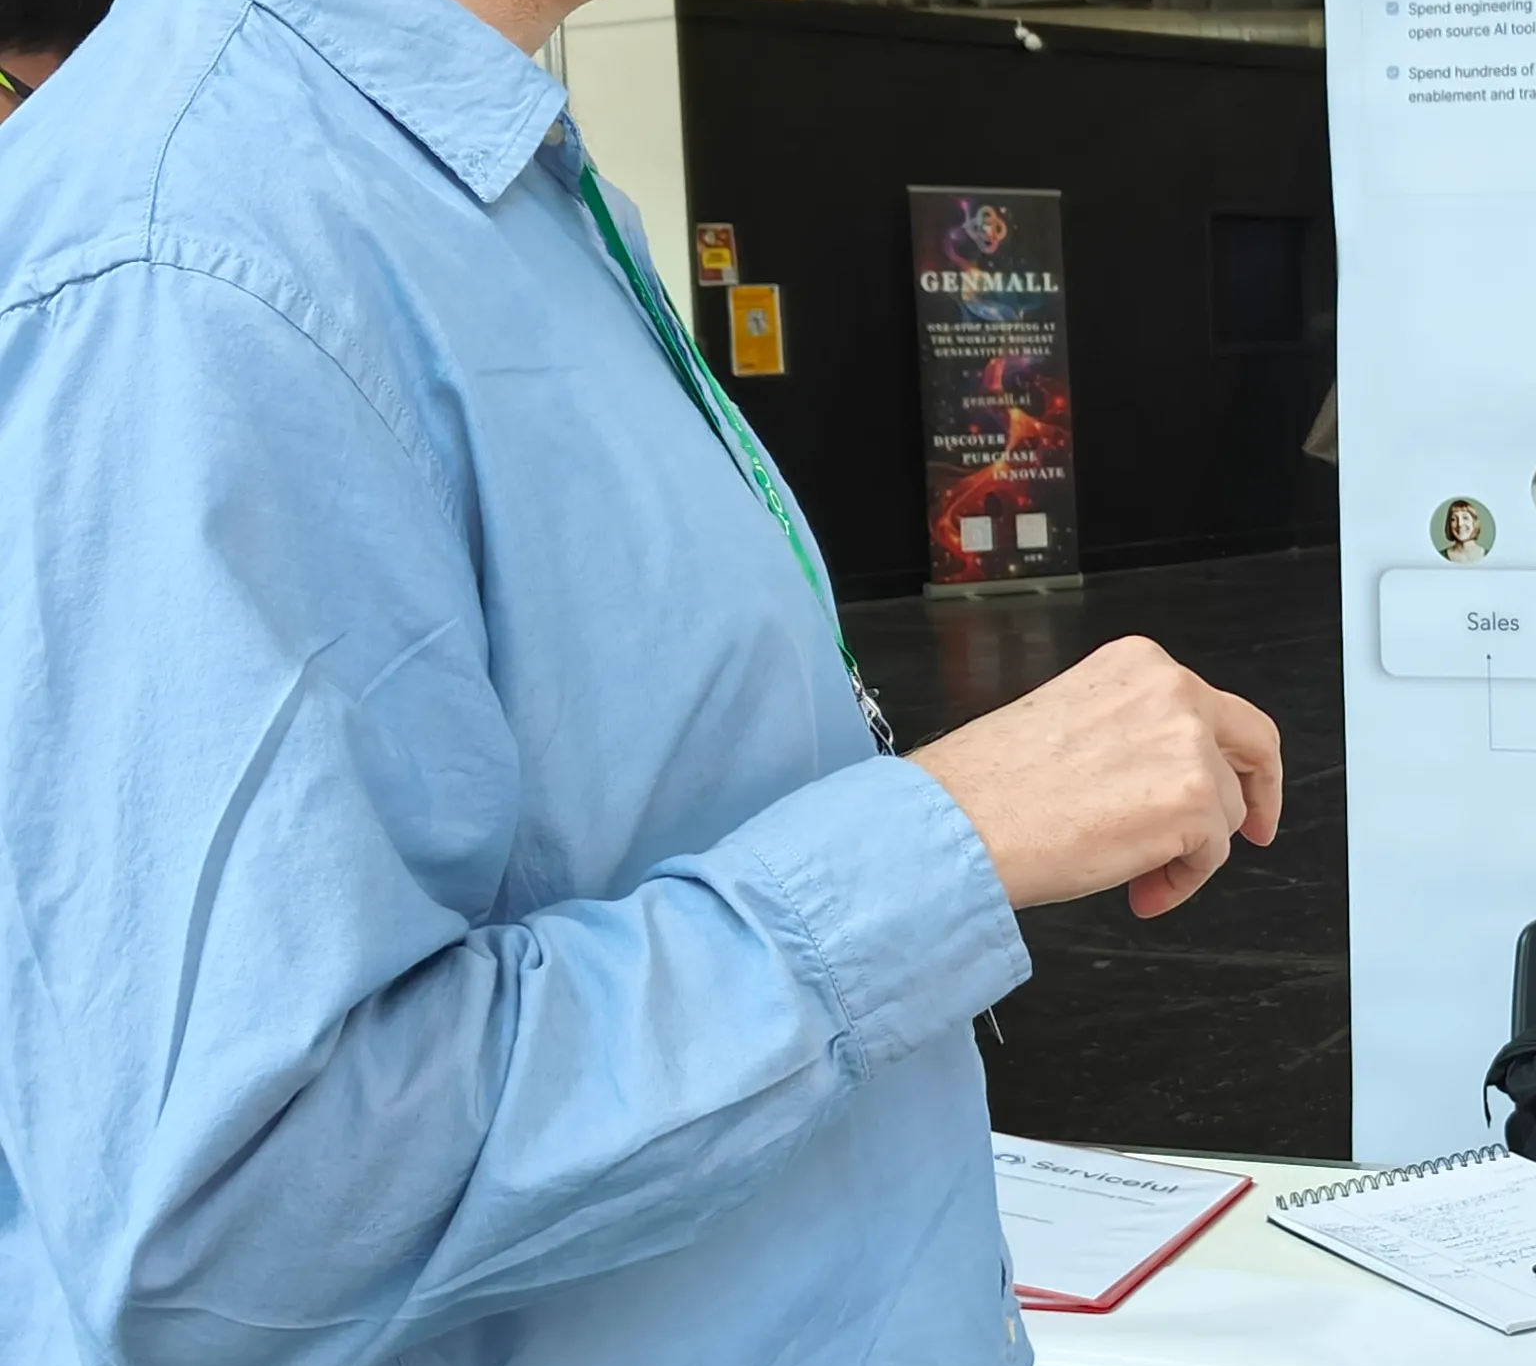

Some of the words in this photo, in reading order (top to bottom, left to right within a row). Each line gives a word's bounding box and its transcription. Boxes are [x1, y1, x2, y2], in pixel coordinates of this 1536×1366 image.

[1408, 2, 1451, 18] Spend
[1408, 26, 1442, 40] open
[1445, 24, 1490, 38] source
[1494, 23, 1507, 36] AI
[1408, 67, 1451, 83] Spend
[1454, 64, 1517, 79] hundreds
[1520, 63, 1535, 77] of
[1408, 88, 1486, 104] enablement
[1490, 87, 1514, 102] and
[920, 270, 1059, 293] GENMALL
[933, 434, 1006, 448] DISCOVER
[962, 451, 1037, 465] PURCHASE
[993, 467, 1065, 481] INNOVATE
[1467, 611, 1520, 633] Sales
[1032, 1160, 1179, 1194] Serviceful
